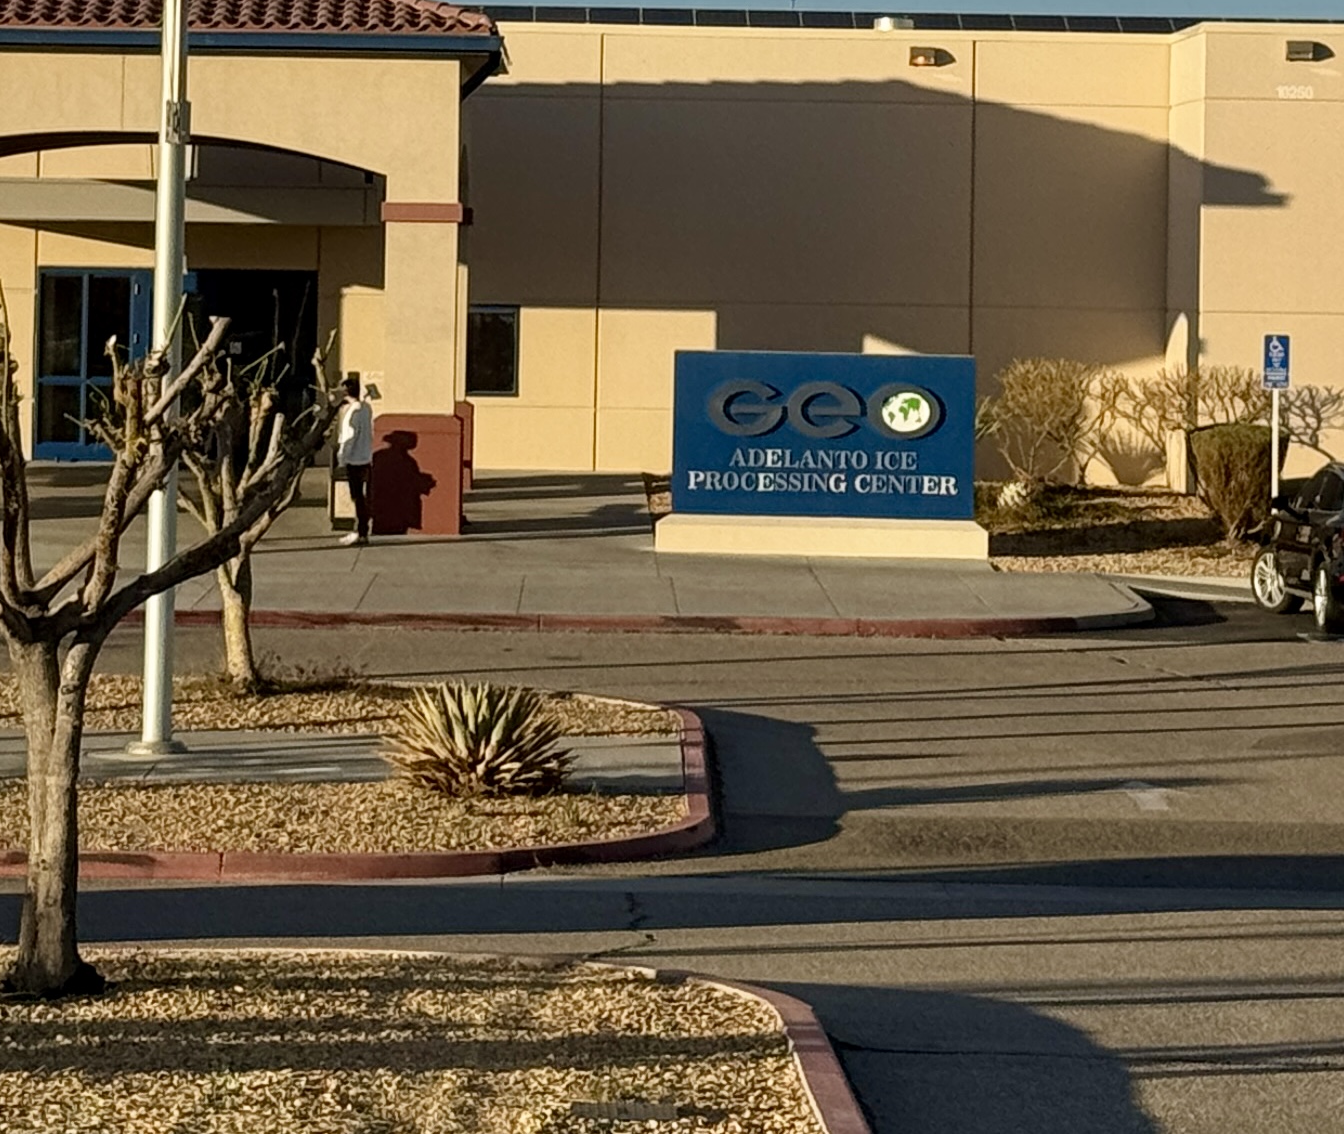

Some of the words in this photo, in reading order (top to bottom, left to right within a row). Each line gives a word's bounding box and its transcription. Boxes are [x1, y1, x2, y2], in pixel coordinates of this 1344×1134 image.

[729, 448, 868, 470] ADELANTO
[876, 450, 918, 471] ICE
[687, 470, 847, 493] PROCESSING
[854, 473, 959, 496] CENTER
